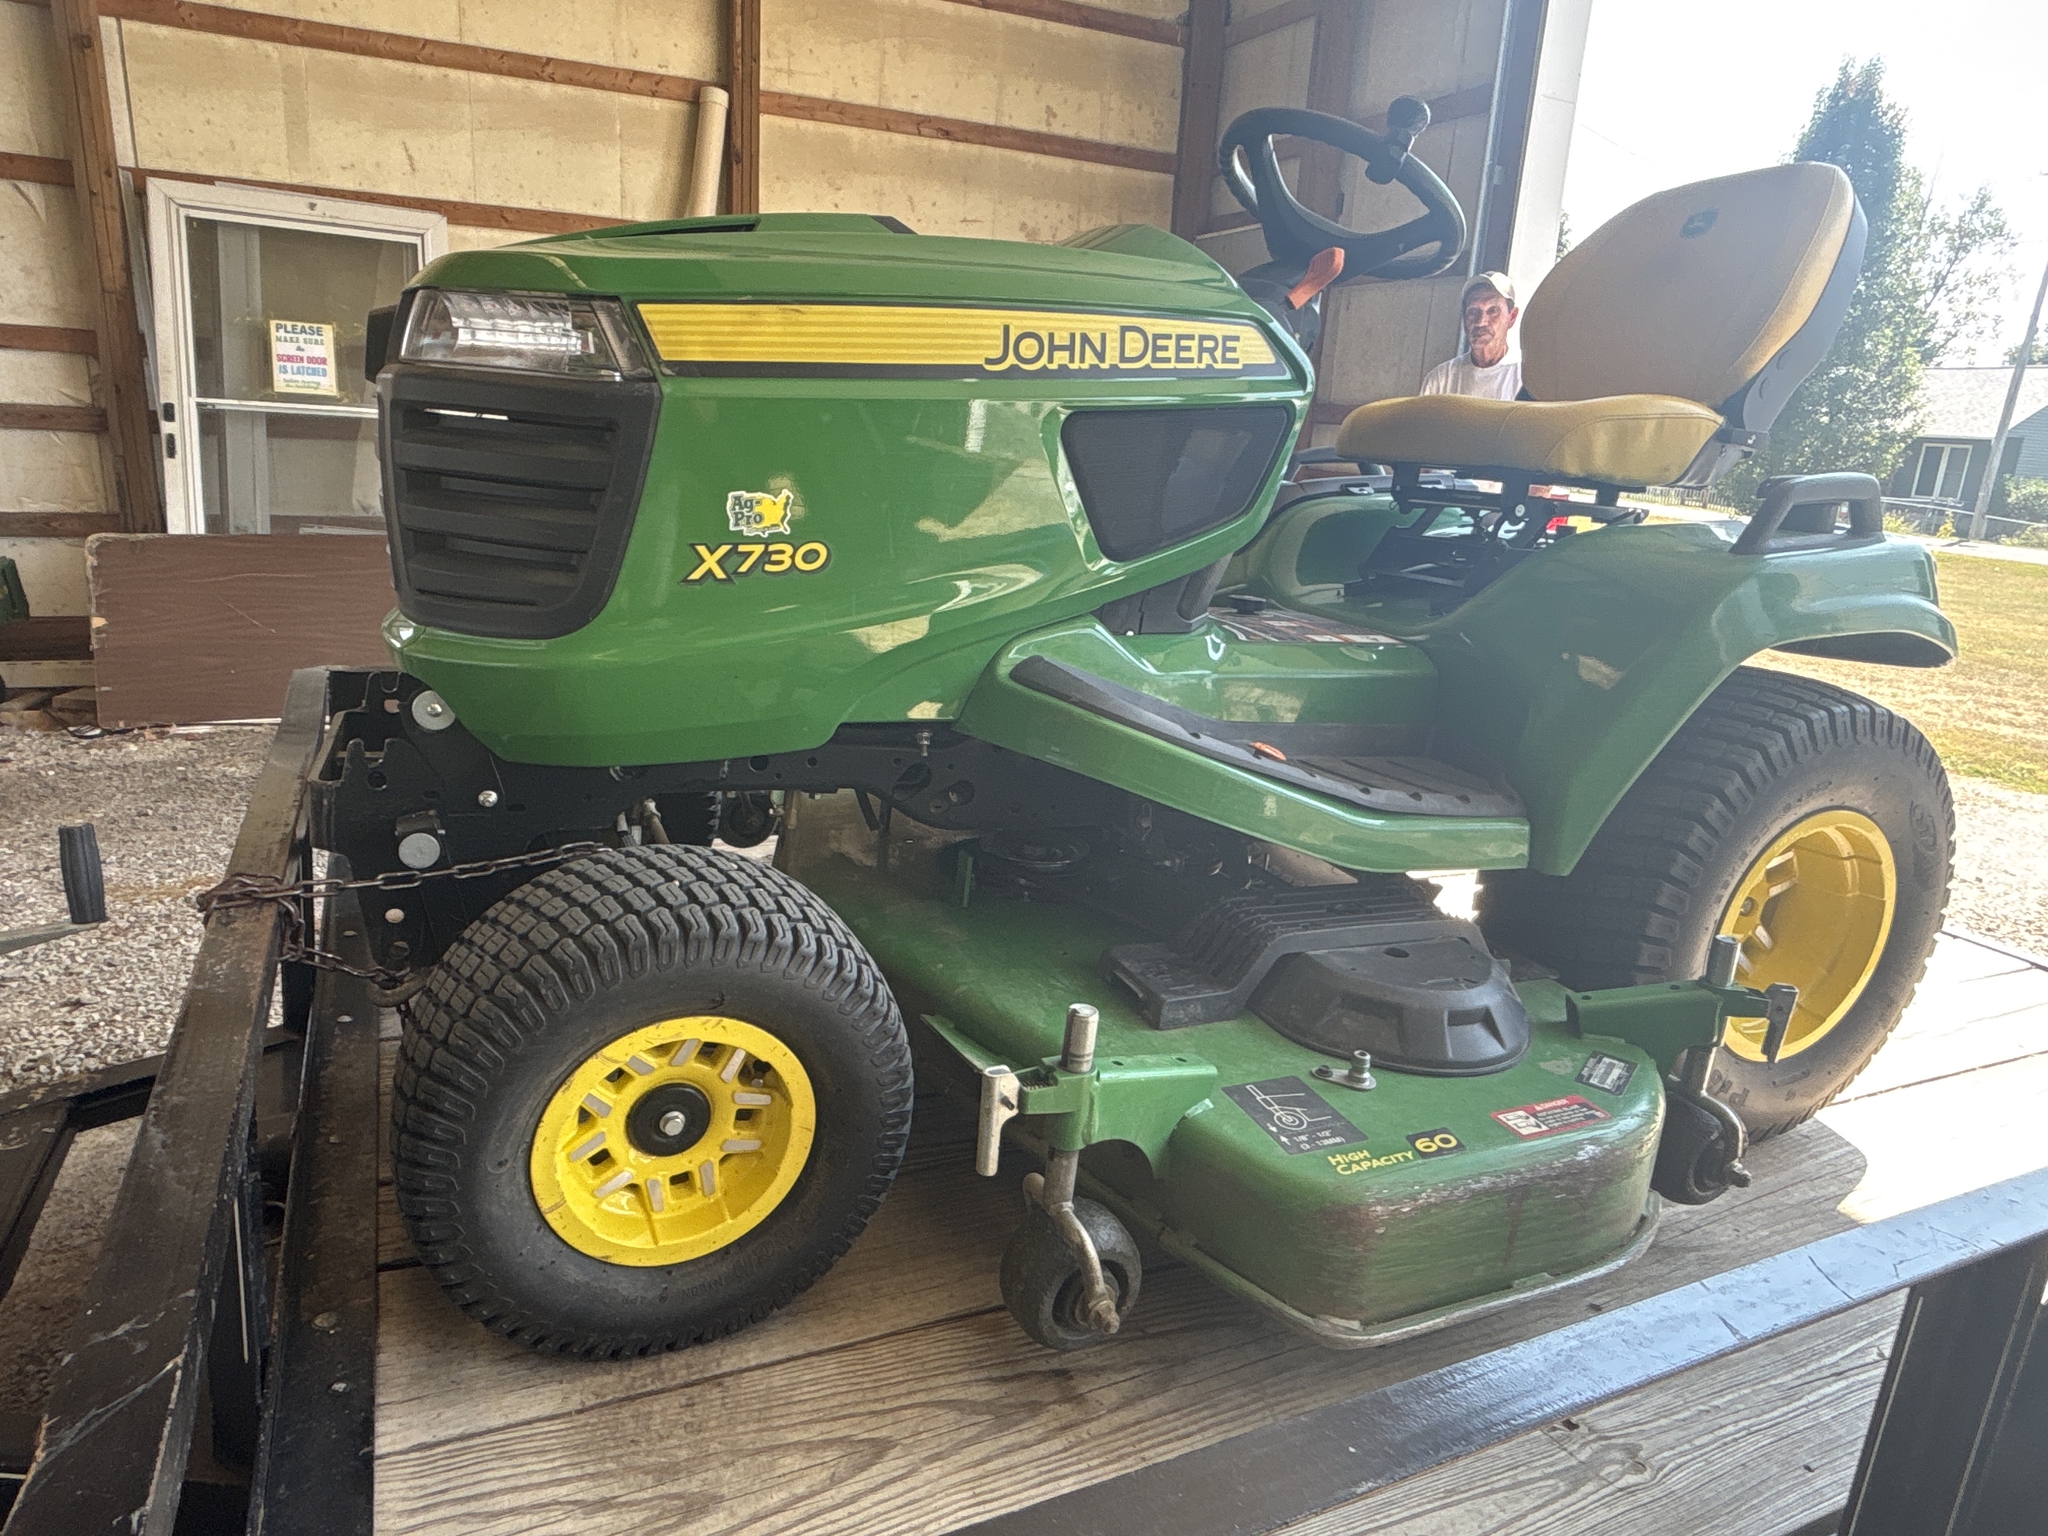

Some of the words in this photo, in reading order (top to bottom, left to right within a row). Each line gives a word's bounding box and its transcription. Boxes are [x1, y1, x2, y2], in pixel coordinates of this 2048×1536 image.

[275, 323, 323, 336] PLEASE
[275, 335, 300, 344] MAKE
[984, 323, 1108, 368] JOHN
[1118, 324, 1242, 367] DEERE
[276, 354, 304, 364] SCREEN
[307, 356, 327, 366] DOOR
[279, 364, 288, 374] IS
[291, 365, 327, 377] LATCHED
[733, 511, 764, 527] Pro
[682, 540, 831, 583] X730
[1414, 1133, 1458, 1153] 60
[1327, 1149, 1371, 1166] HIGH
[1336, 1150, 1414, 1175] CAPACITY
